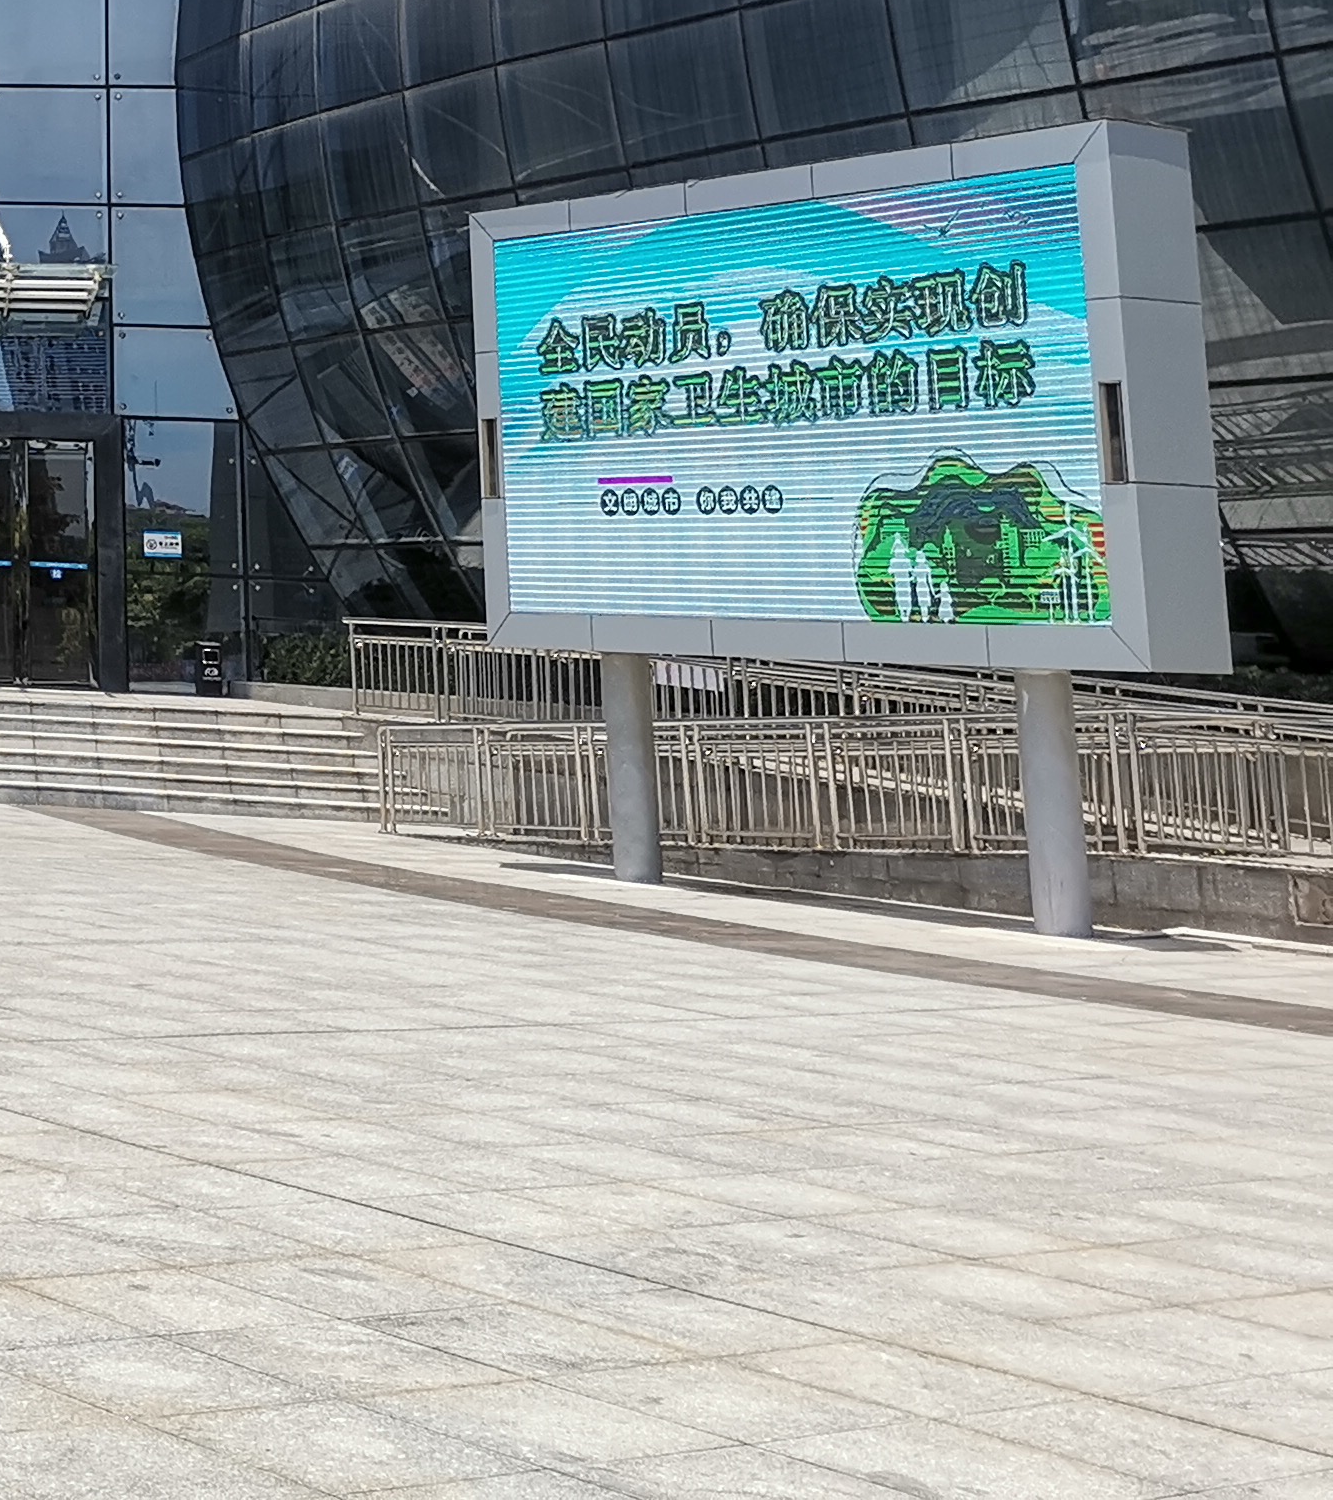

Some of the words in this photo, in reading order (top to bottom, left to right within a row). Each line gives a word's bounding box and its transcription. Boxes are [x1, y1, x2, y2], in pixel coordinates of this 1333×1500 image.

[537, 339, 1036, 442] 建国家卫生城市的目标
[601, 488, 681, 515] 文明城市
